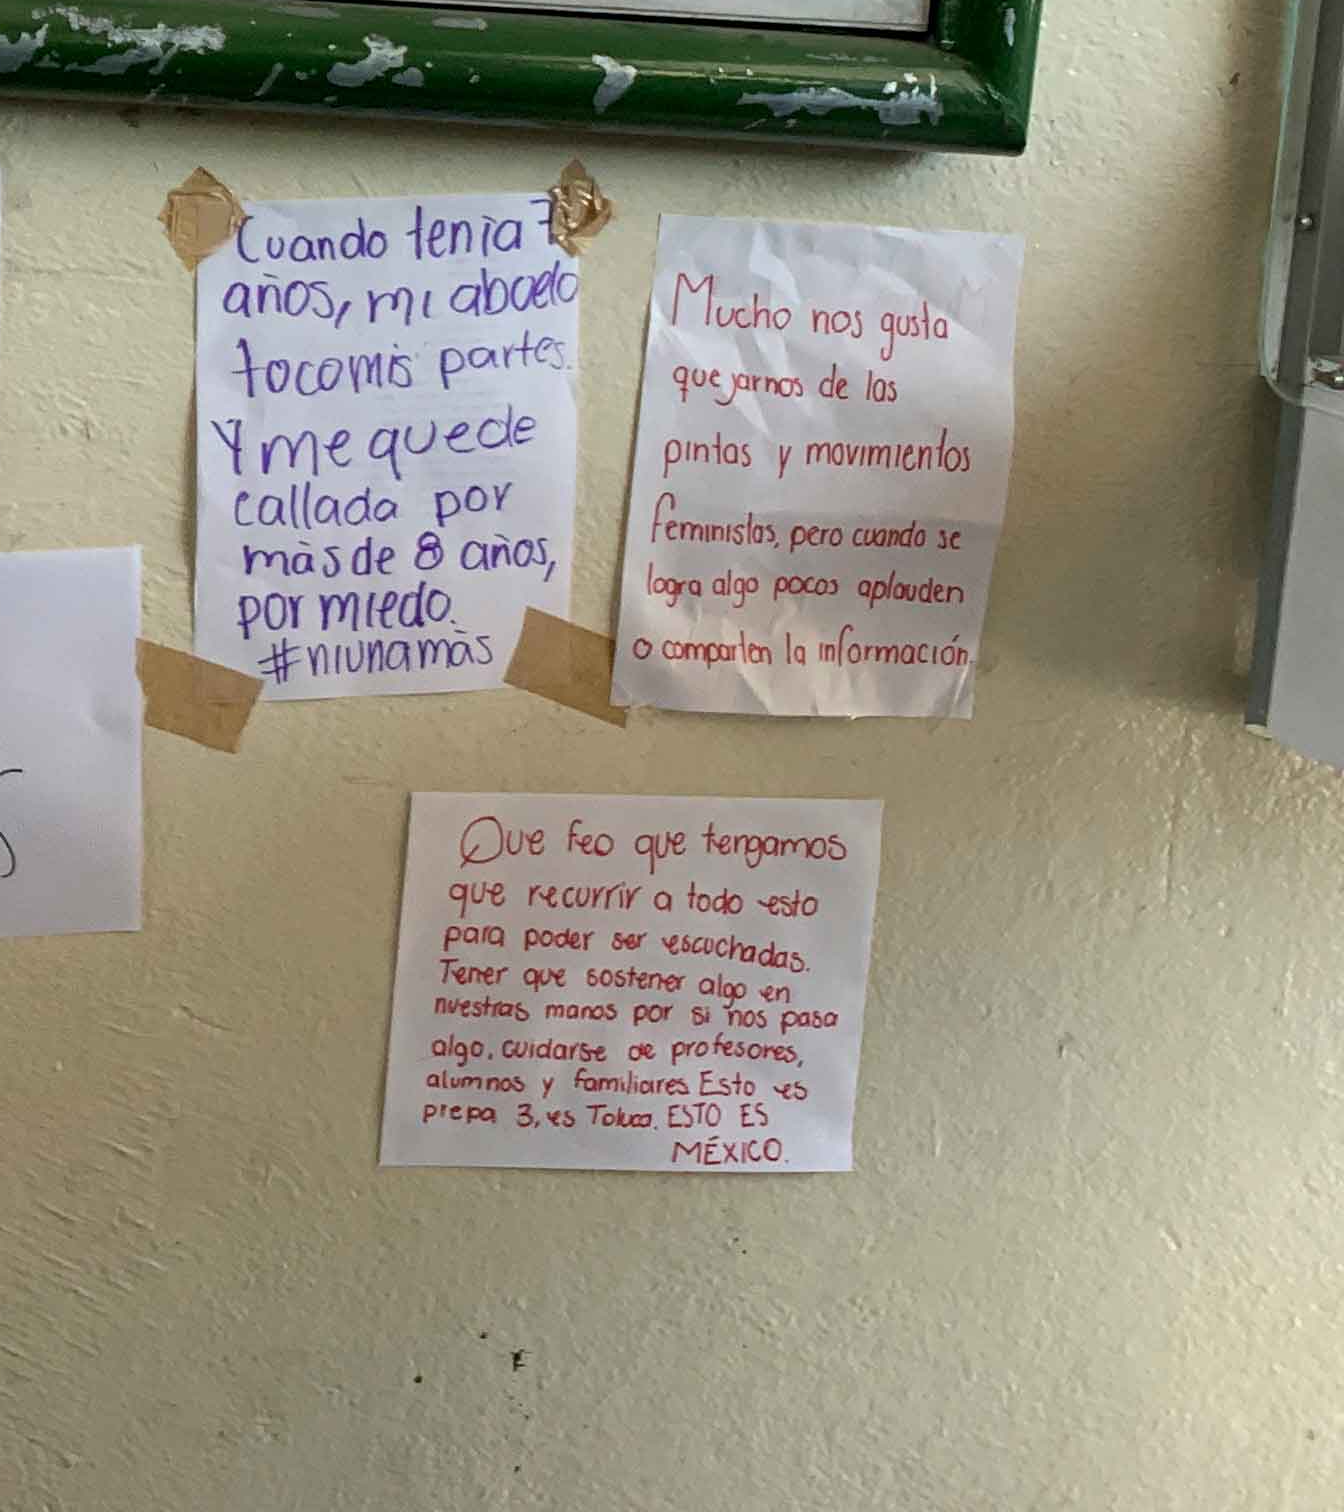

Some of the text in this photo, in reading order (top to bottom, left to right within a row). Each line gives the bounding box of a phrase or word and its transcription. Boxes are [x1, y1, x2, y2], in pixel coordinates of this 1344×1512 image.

[670, 272, 950, 363] Mucho nos gusta
[459, 815, 848, 874] Que feo que tengamos
